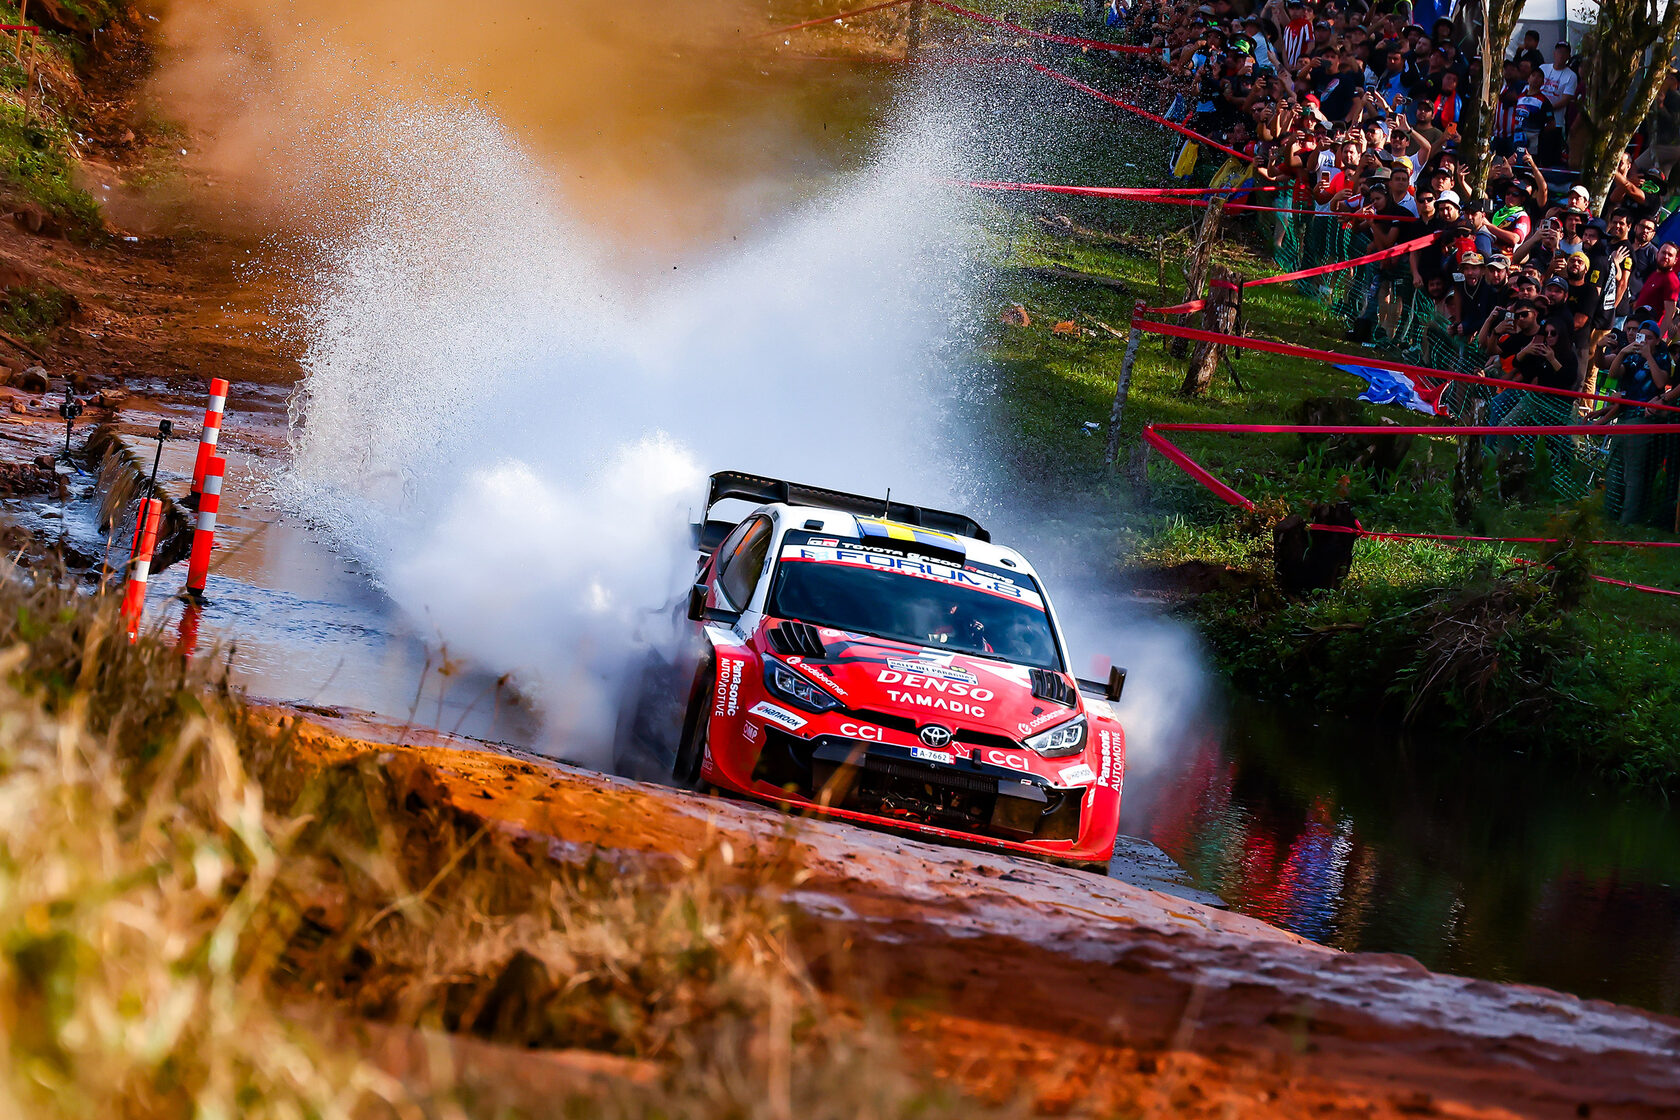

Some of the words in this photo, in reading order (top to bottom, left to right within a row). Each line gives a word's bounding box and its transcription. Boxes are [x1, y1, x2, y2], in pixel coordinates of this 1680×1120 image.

[842, 542, 903, 556] TOYOTA
[964, 565, 1014, 584] Racing
[714, 657, 731, 717] AUTOMOTIVE
[727, 659, 745, 717] Panasonic
[800, 663, 848, 696] codebeamer
[877, 669, 994, 702] DENSO
[887, 690, 985, 718] TAMADIC
[743, 723, 758, 740] OMP
[840, 723, 883, 741] CCI
[920, 750, 947, 761] A-7662
[988, 750, 1030, 771] CCI
[1097, 729, 1111, 788] Panasonic
[1110, 731, 1123, 792] AUTOMOTIVE
